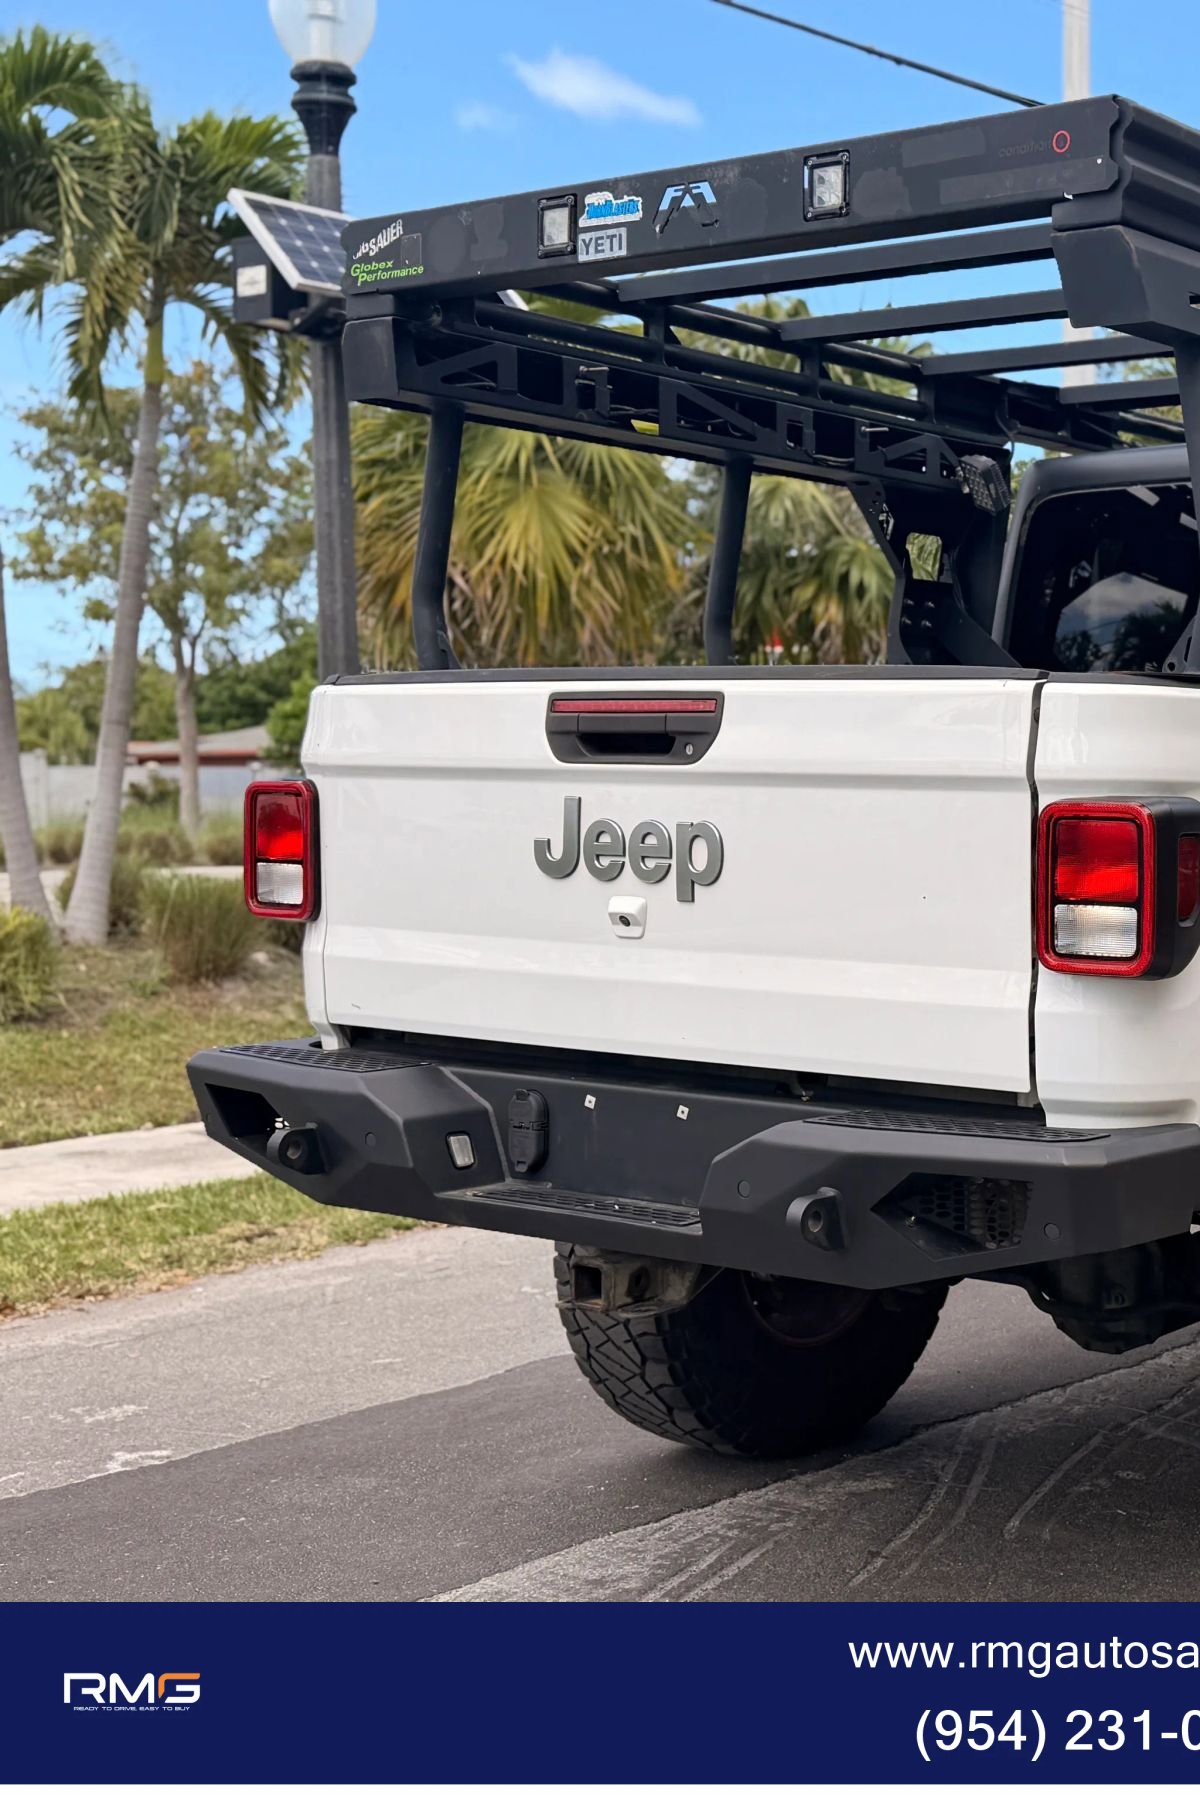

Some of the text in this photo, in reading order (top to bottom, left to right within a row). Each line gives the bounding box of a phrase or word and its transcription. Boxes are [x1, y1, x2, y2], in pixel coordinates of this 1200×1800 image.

[368, 218, 404, 257] SAUER
[580, 233, 623, 256] YETI
[350, 259, 394, 277] Globex
[356, 264, 424, 287] Performance
[533, 796, 724, 903] Jeep
